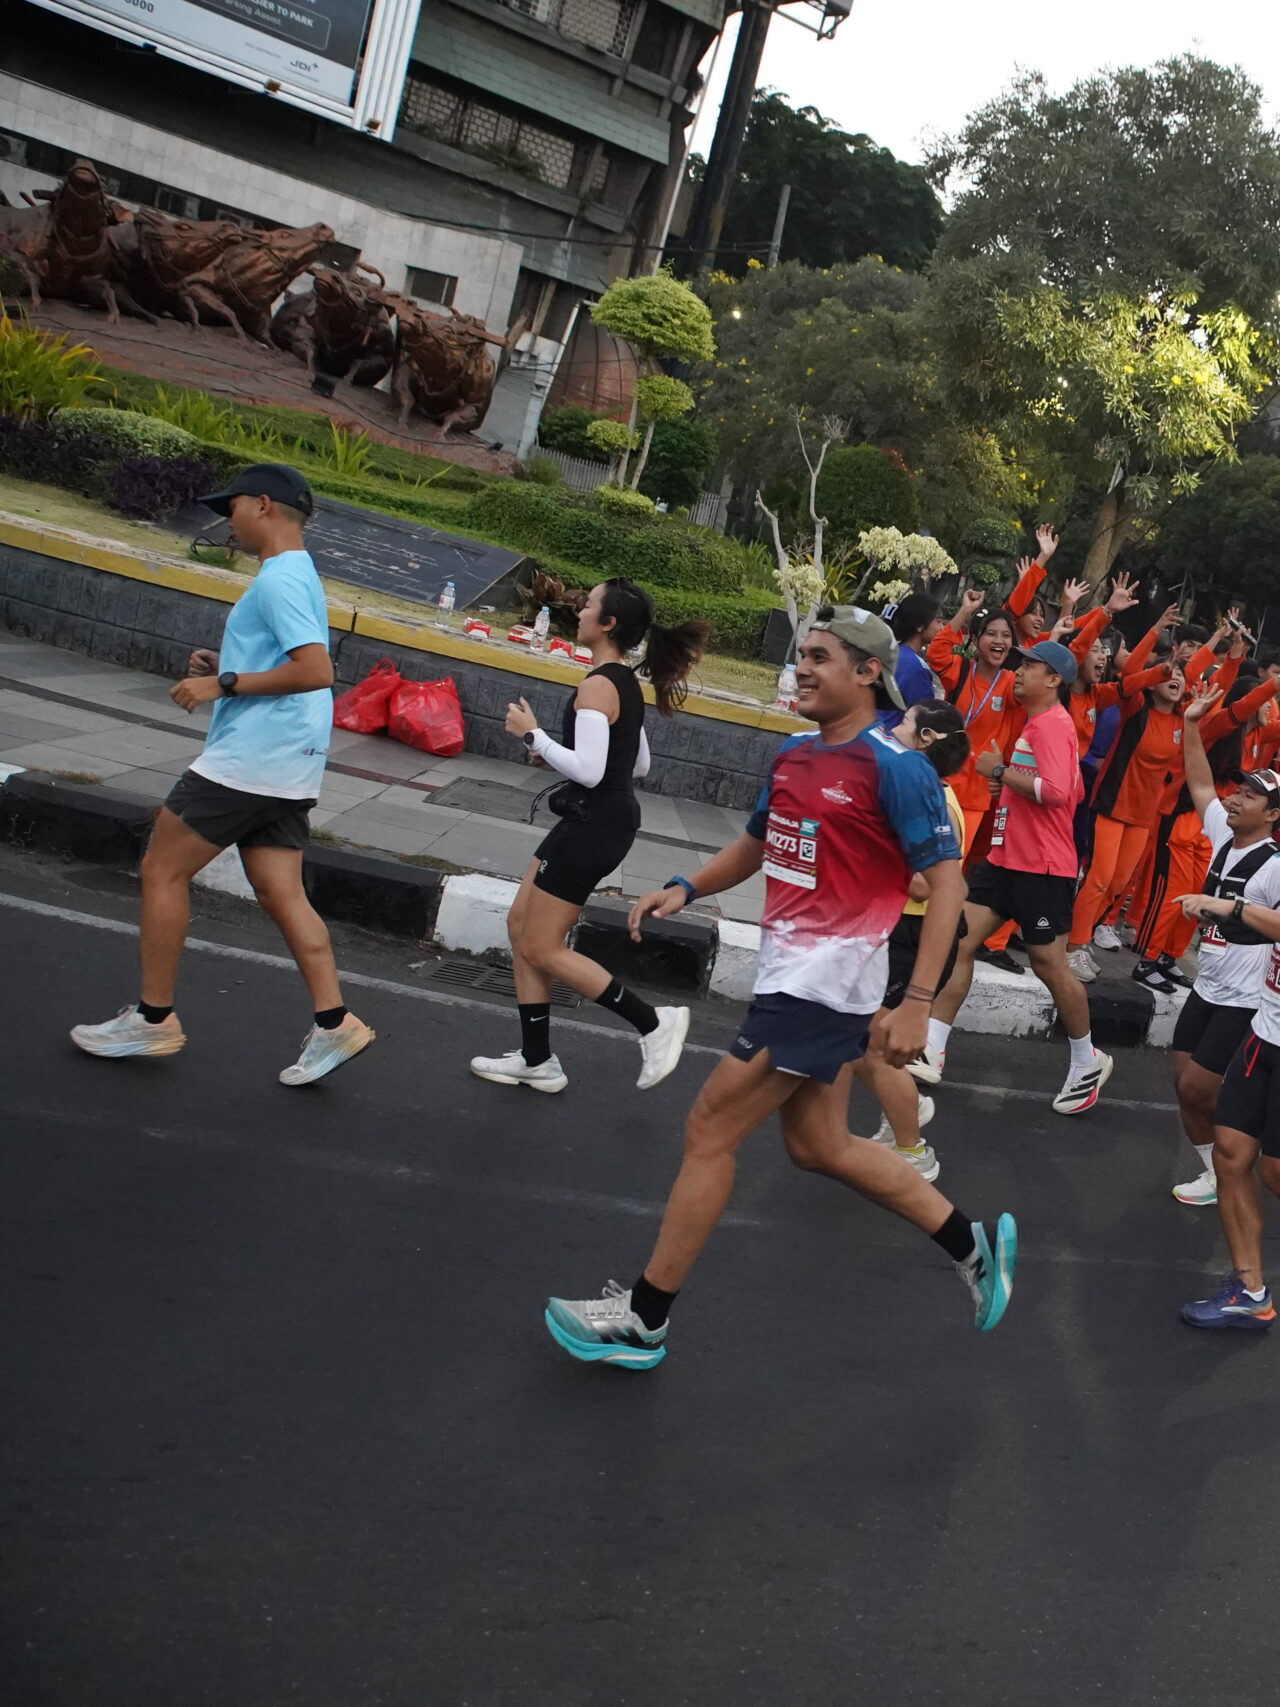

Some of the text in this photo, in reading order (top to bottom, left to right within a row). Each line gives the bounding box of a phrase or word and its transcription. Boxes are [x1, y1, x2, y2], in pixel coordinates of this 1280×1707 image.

[277, 4, 289, 17] TO
[290, 9, 314, 28] PARK
[766, 828, 797, 853] M1273
